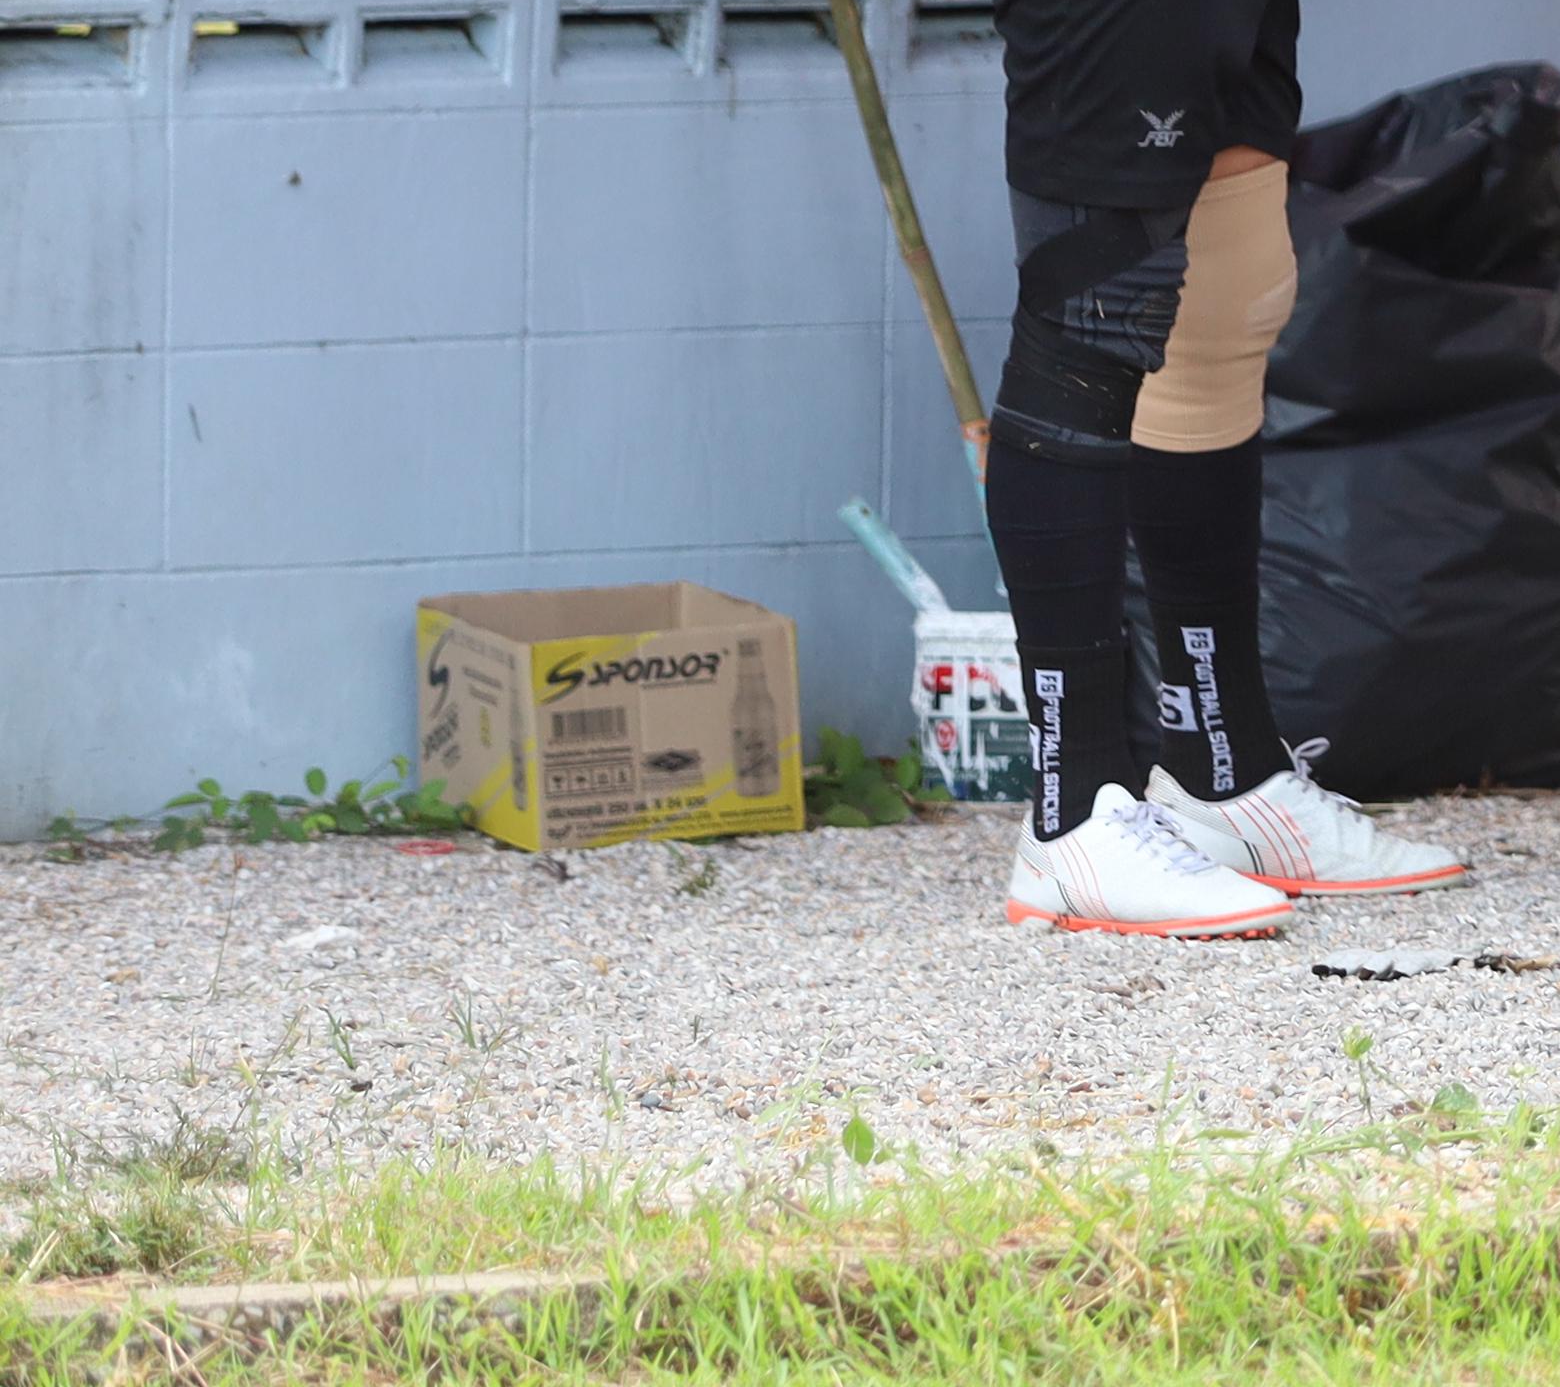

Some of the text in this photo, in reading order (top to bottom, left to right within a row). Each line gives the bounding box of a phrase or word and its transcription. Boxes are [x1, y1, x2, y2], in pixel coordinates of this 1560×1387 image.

[1194, 652, 1225, 732] FOOTBALL
[1042, 696, 1062, 772] FOOTBALL
[1208, 730, 1236, 793] SOCKS
[1042, 772, 1061, 834] SOCKS
